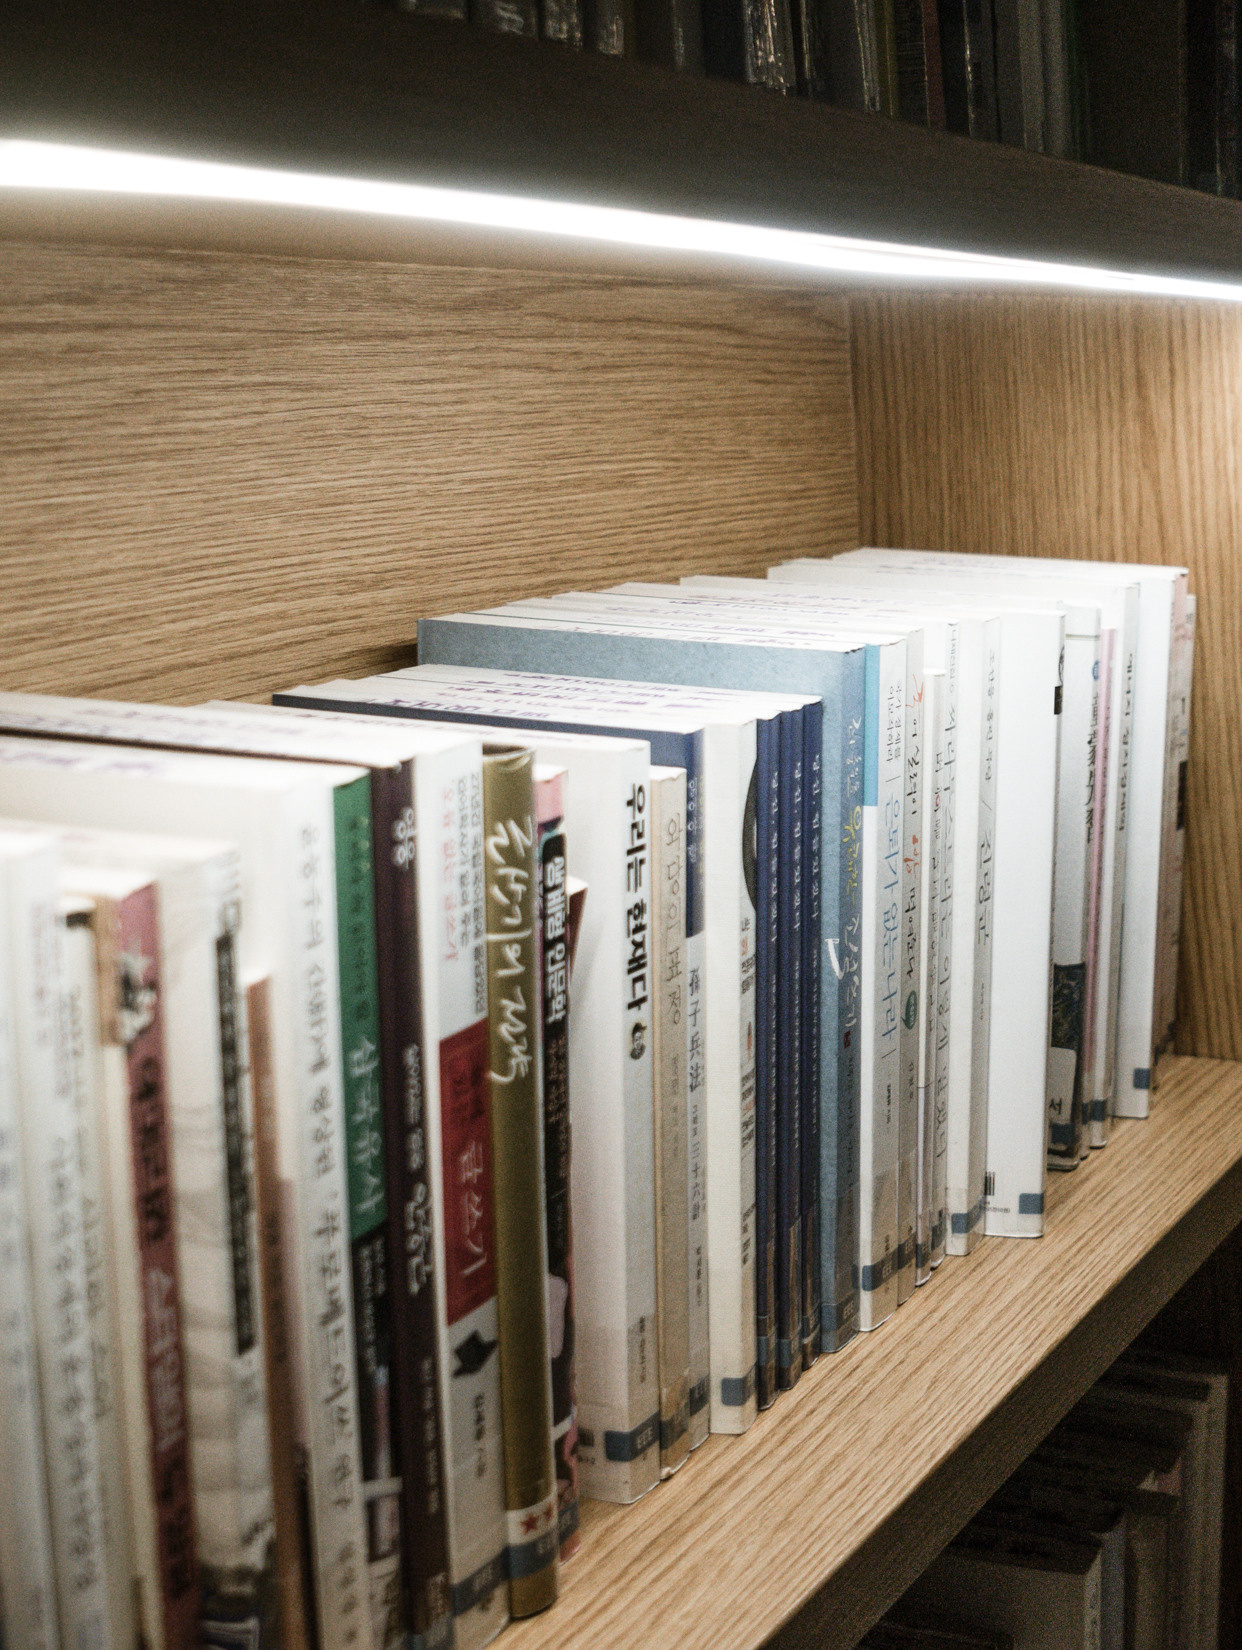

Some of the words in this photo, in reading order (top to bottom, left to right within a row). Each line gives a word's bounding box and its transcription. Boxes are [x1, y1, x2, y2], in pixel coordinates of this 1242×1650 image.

[625, 783, 649, 894] 우리는
[884, 794, 901, 895] 은퇴가
[543, 855, 567, 937] 생계형
[883, 902, 898, 968] 없는
[545, 936, 568, 1024] 인문학
[625, 898, 649, 1014] 현재다
[882, 970, 898, 1041] 나라
[348, 1034, 385, 1216] 삼국유사
[459, 1139, 488, 1278] 글쓰기
